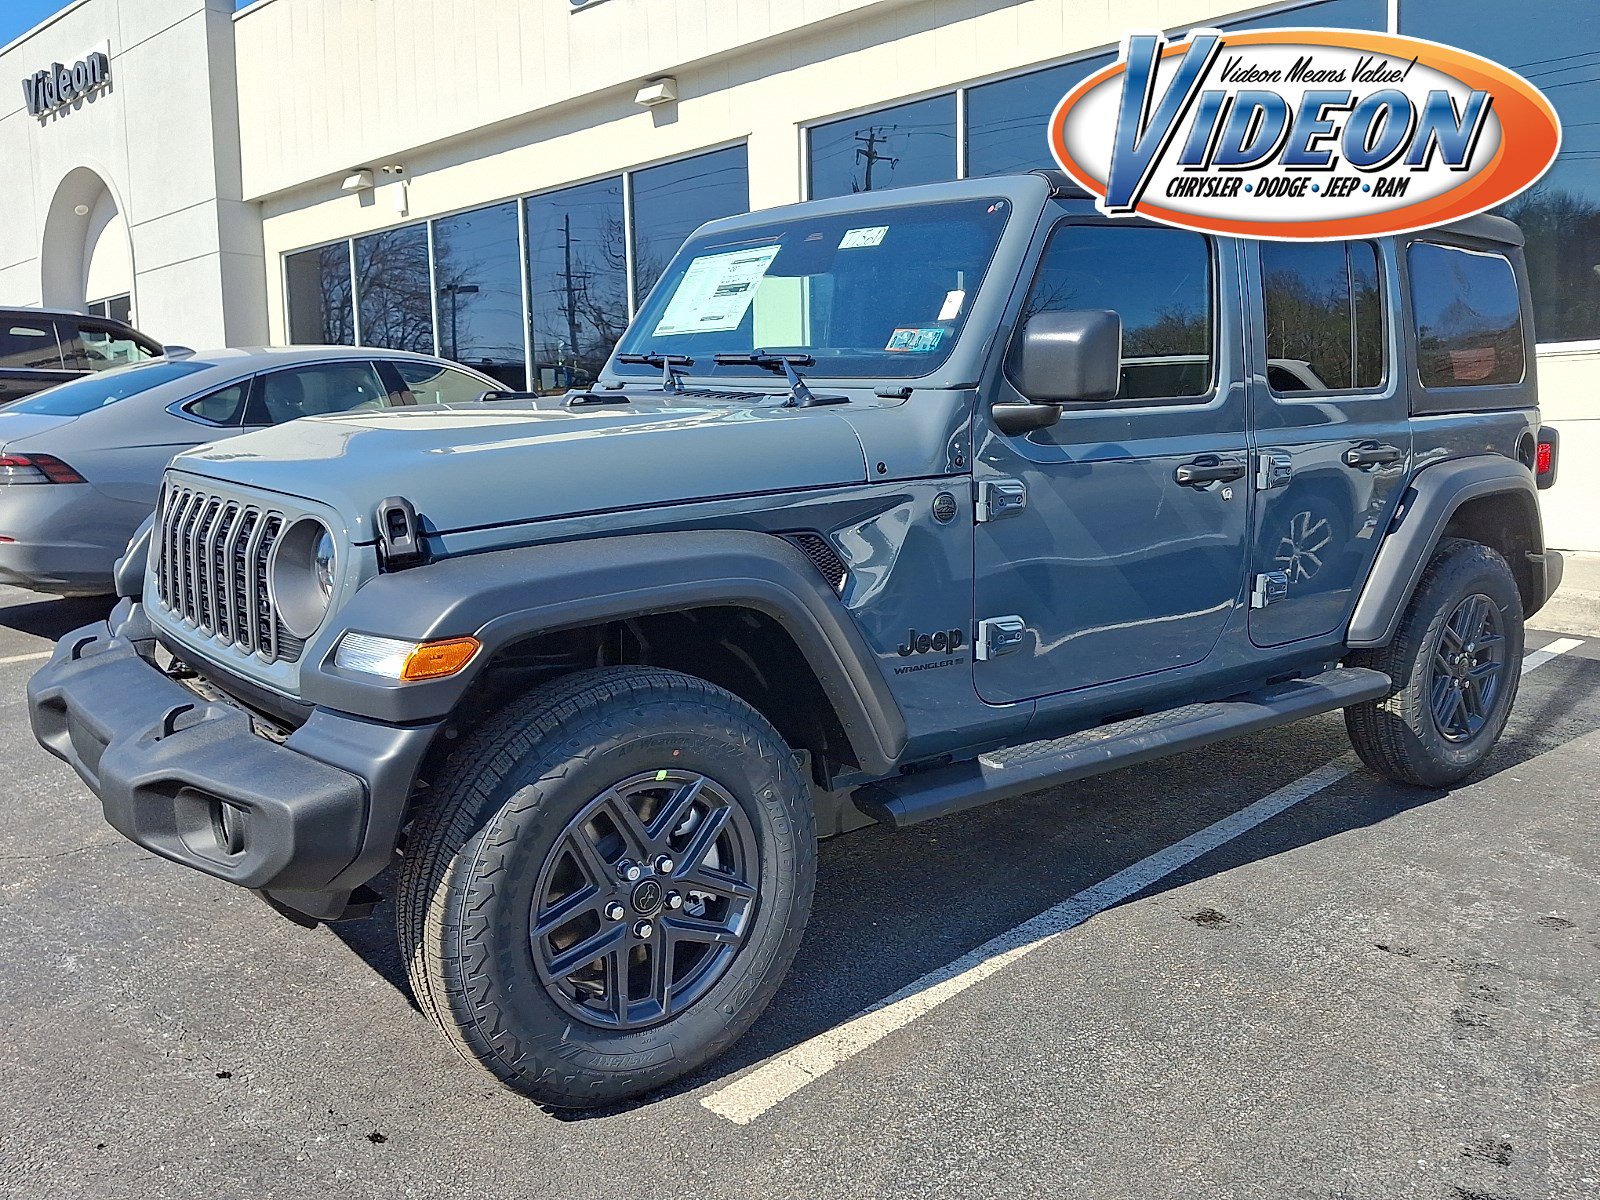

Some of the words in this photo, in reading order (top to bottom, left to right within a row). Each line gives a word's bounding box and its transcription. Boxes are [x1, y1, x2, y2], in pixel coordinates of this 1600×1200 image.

[22, 51, 109, 117] Videon
[896, 627, 963, 657] Jeep
[893, 659, 954, 675] WRANGLER
